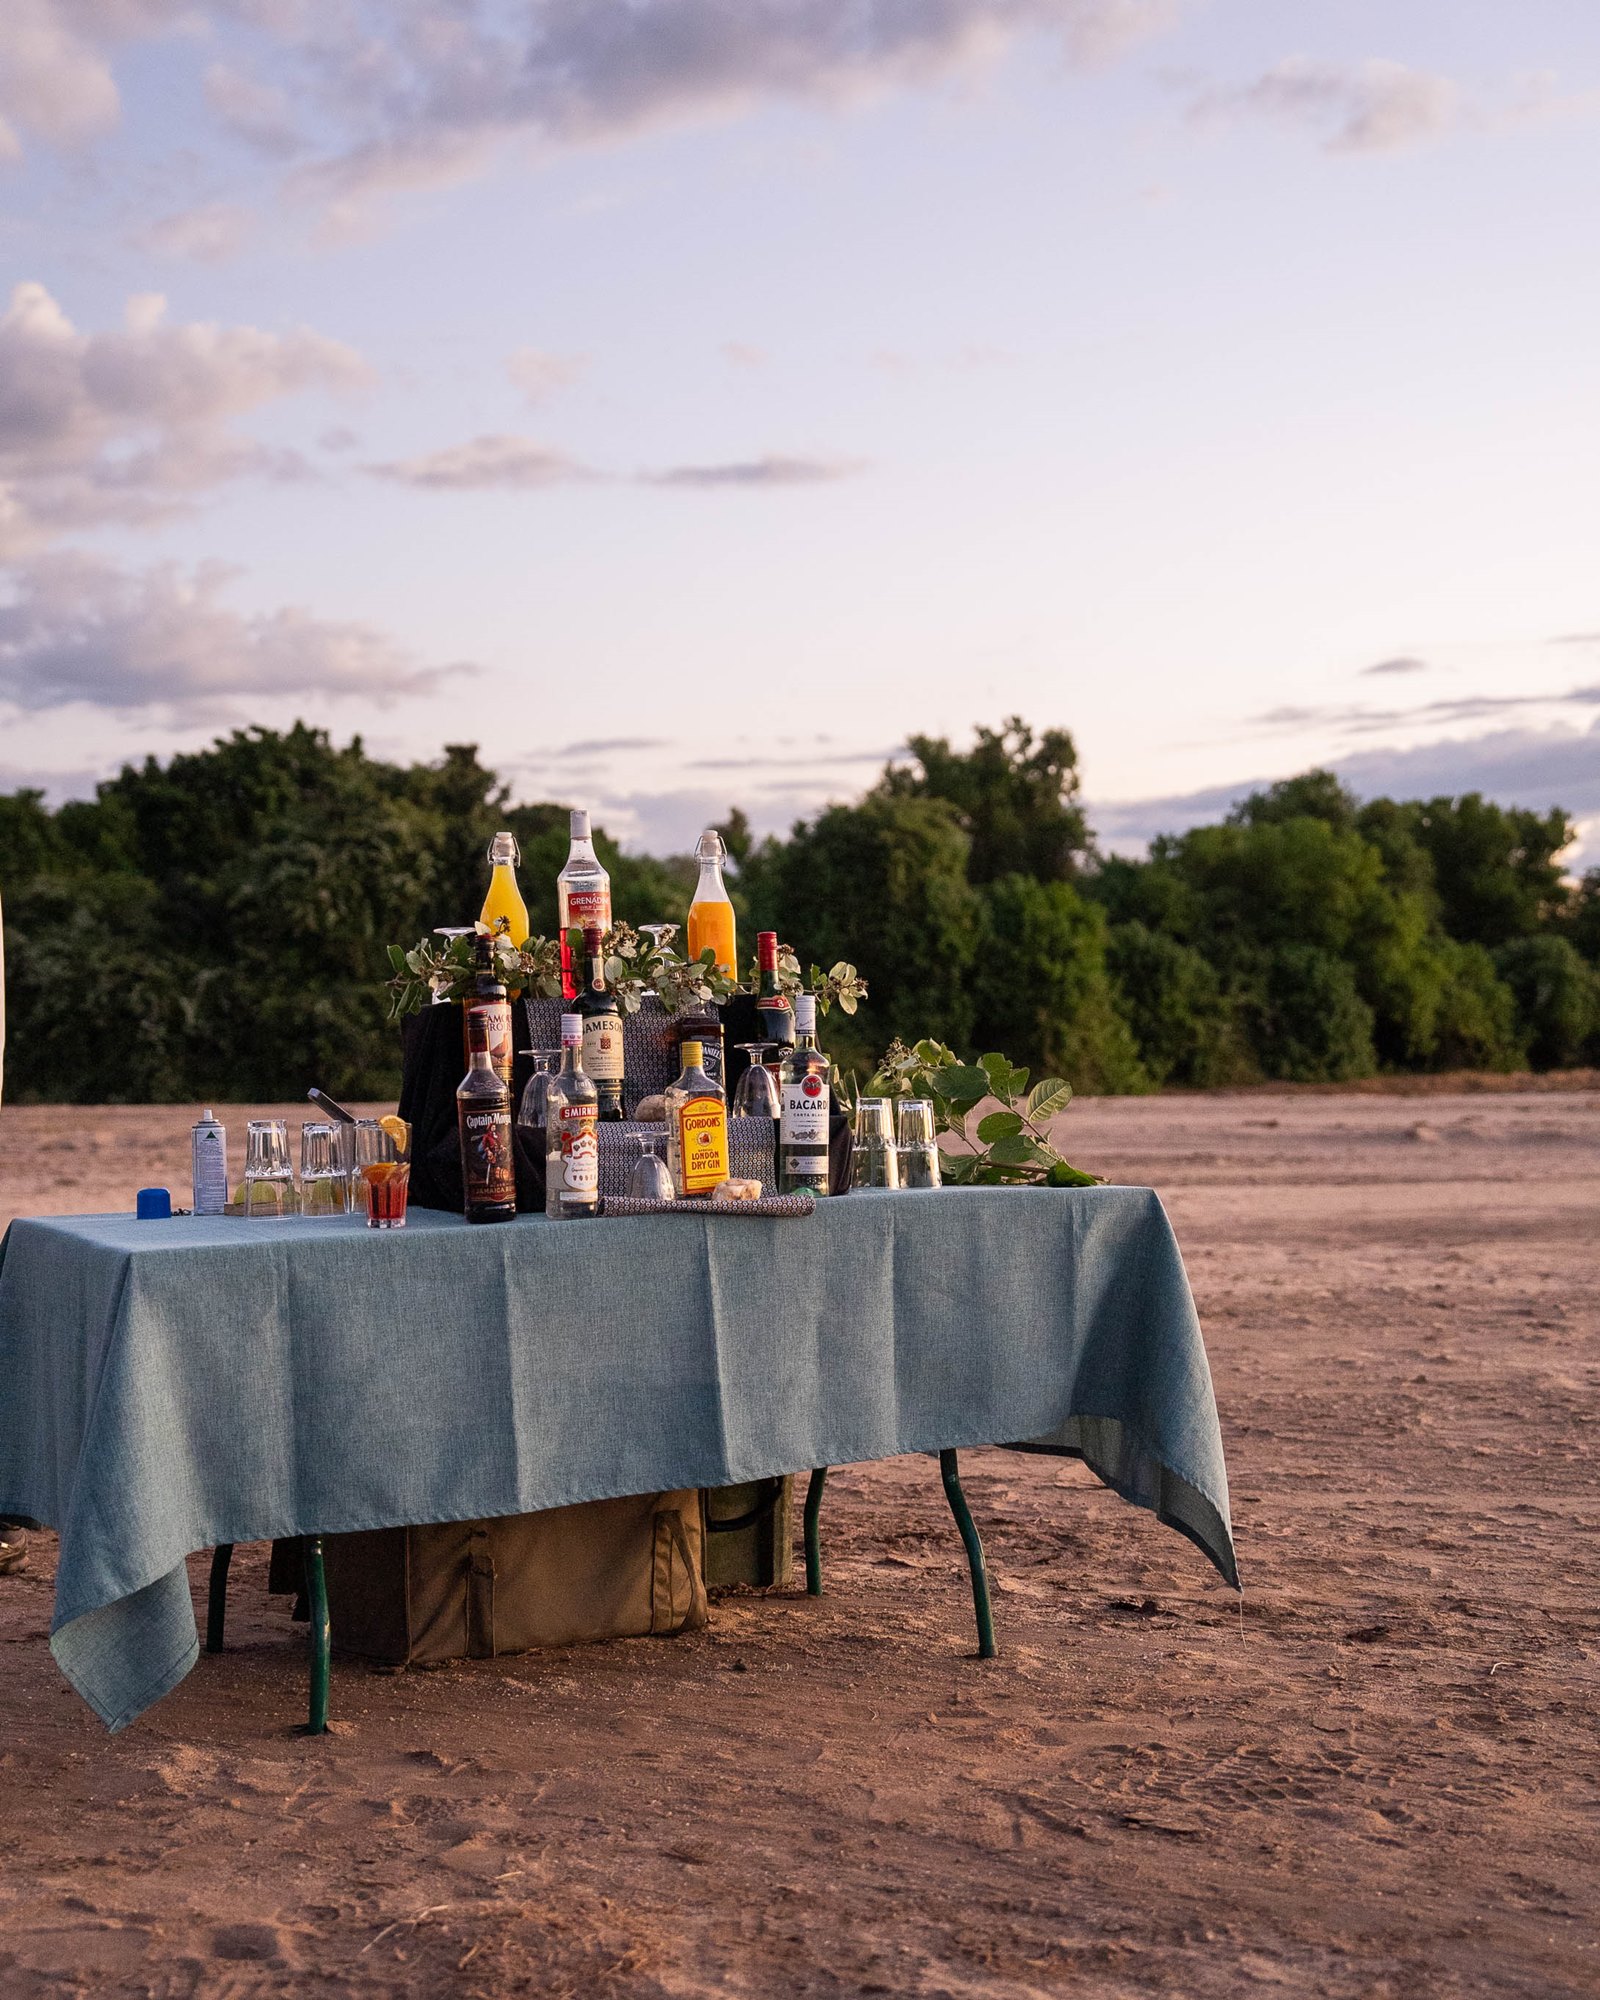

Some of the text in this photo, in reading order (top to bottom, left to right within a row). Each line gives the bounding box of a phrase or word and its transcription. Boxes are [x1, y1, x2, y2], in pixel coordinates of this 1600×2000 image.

[564, 1107, 598, 1118] SMIRNOF
[466, 1112, 511, 1129] Captain Morga
[685, 1117, 720, 1131] GORDON'S
[691, 1151, 719, 1161] LONDON
[691, 1159, 720, 1171] DRY GIN
